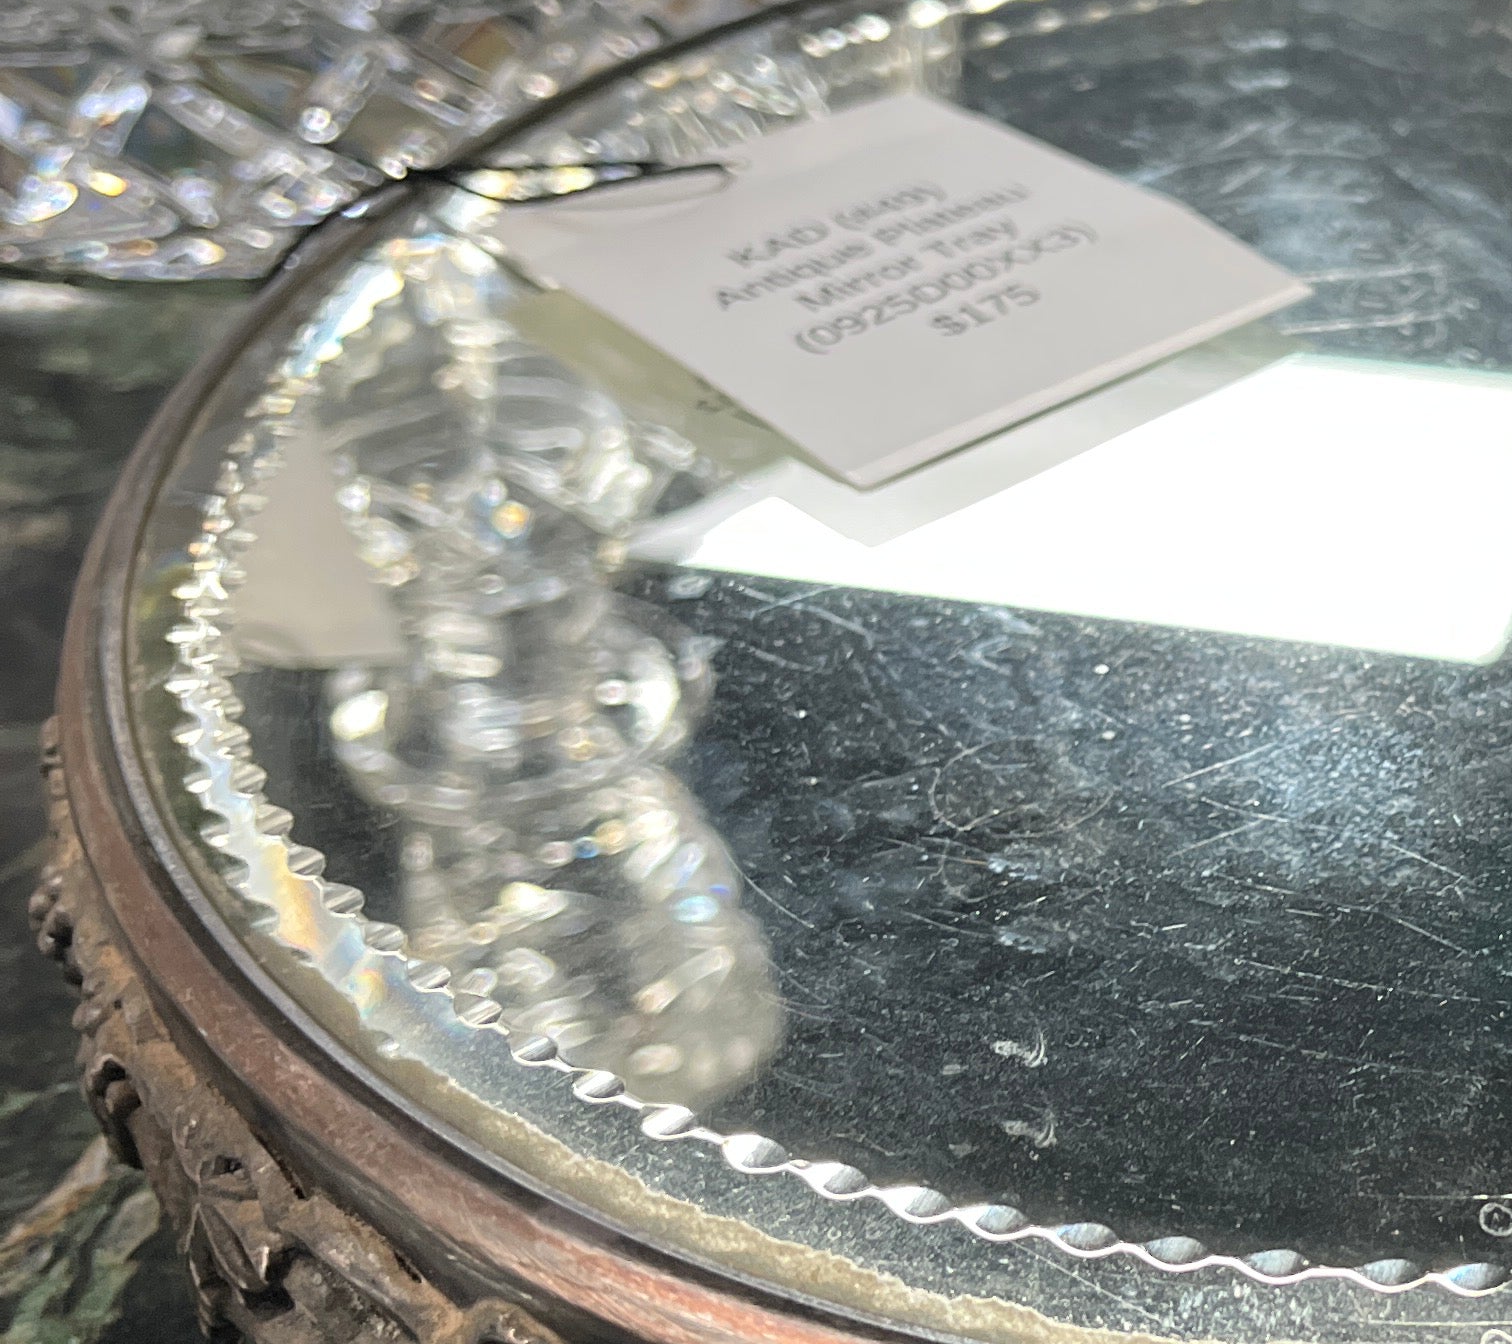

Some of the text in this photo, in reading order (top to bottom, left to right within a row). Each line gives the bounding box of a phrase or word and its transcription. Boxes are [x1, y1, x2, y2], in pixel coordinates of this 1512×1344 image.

[716, 239, 876, 312] Antique
[793, 214, 1018, 313] Mirror Tray
[928, 280, 1043, 337] $175
